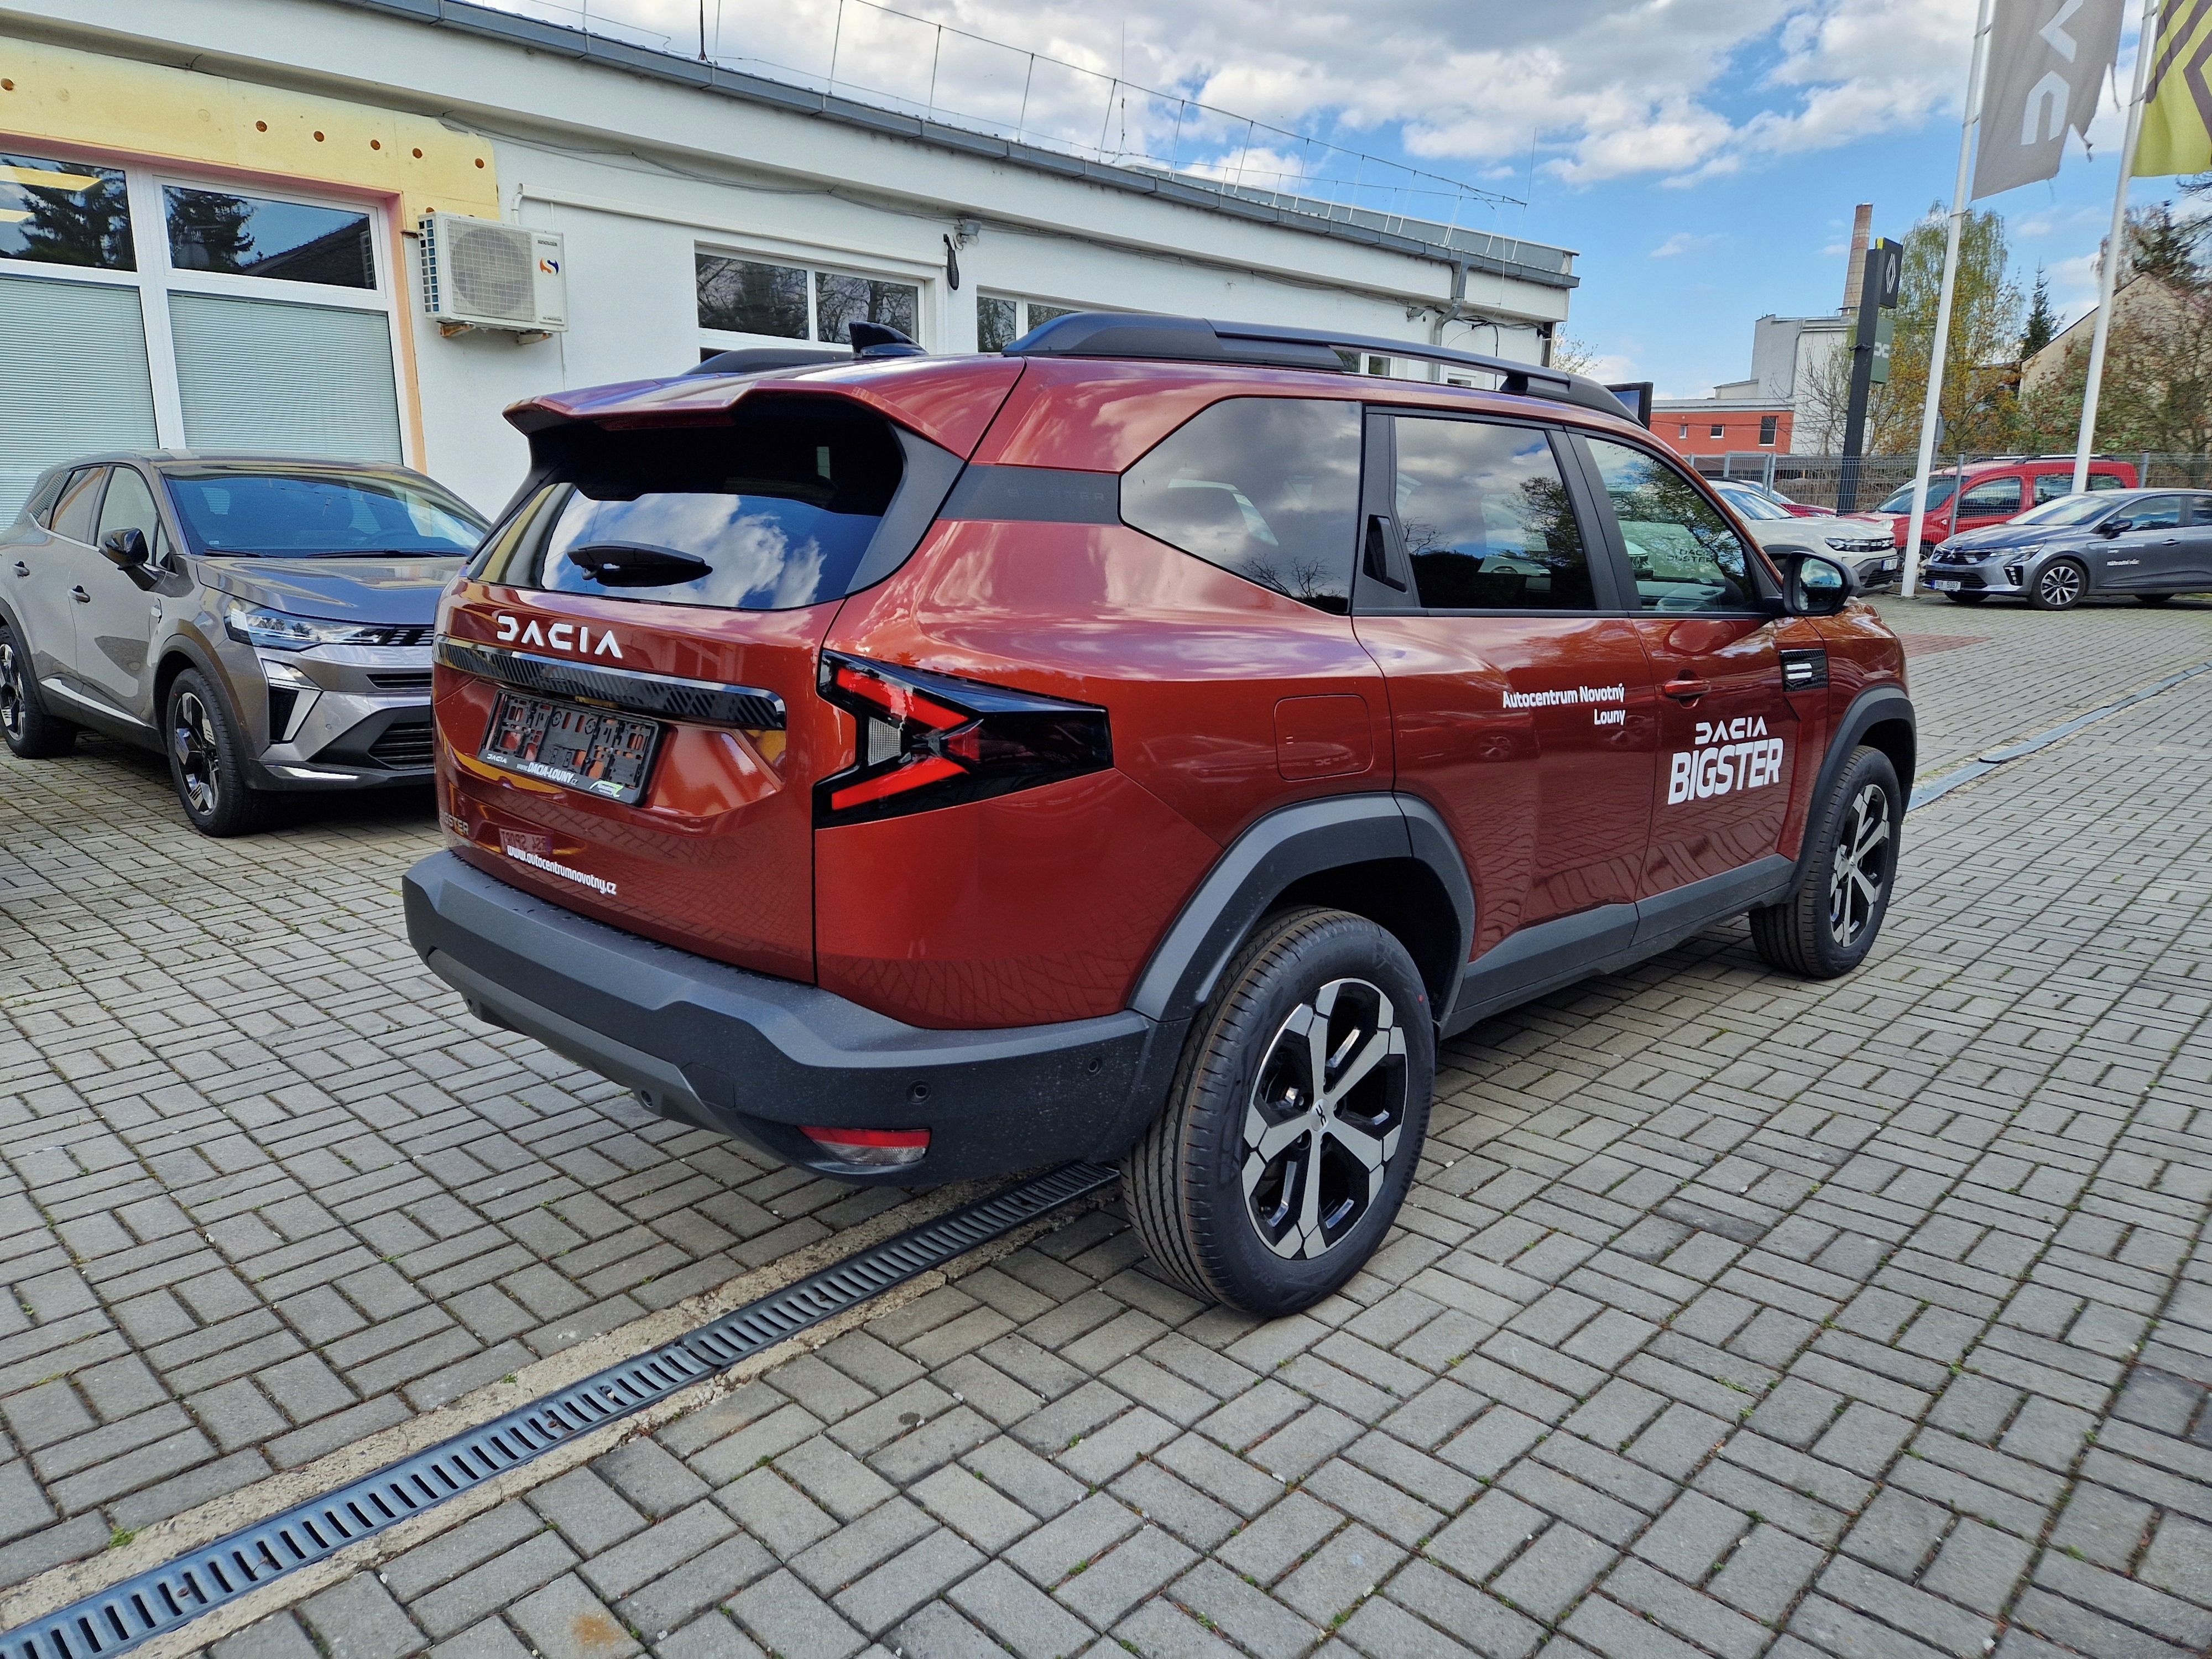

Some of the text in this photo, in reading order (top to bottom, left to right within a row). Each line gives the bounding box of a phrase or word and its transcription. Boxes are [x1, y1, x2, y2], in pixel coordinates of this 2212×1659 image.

[497, 615, 623, 659] DACIA
[1502, 682, 1625, 709] Autocentrum Novotný
[1594, 708, 1626, 726] Louny
[1695, 715, 1768, 745] DACIA
[487, 754, 507, 764] DACIA
[1667, 738, 1784, 805] BIGSTER
[507, 845, 617, 895] www.autocentrumnovotny.cz
